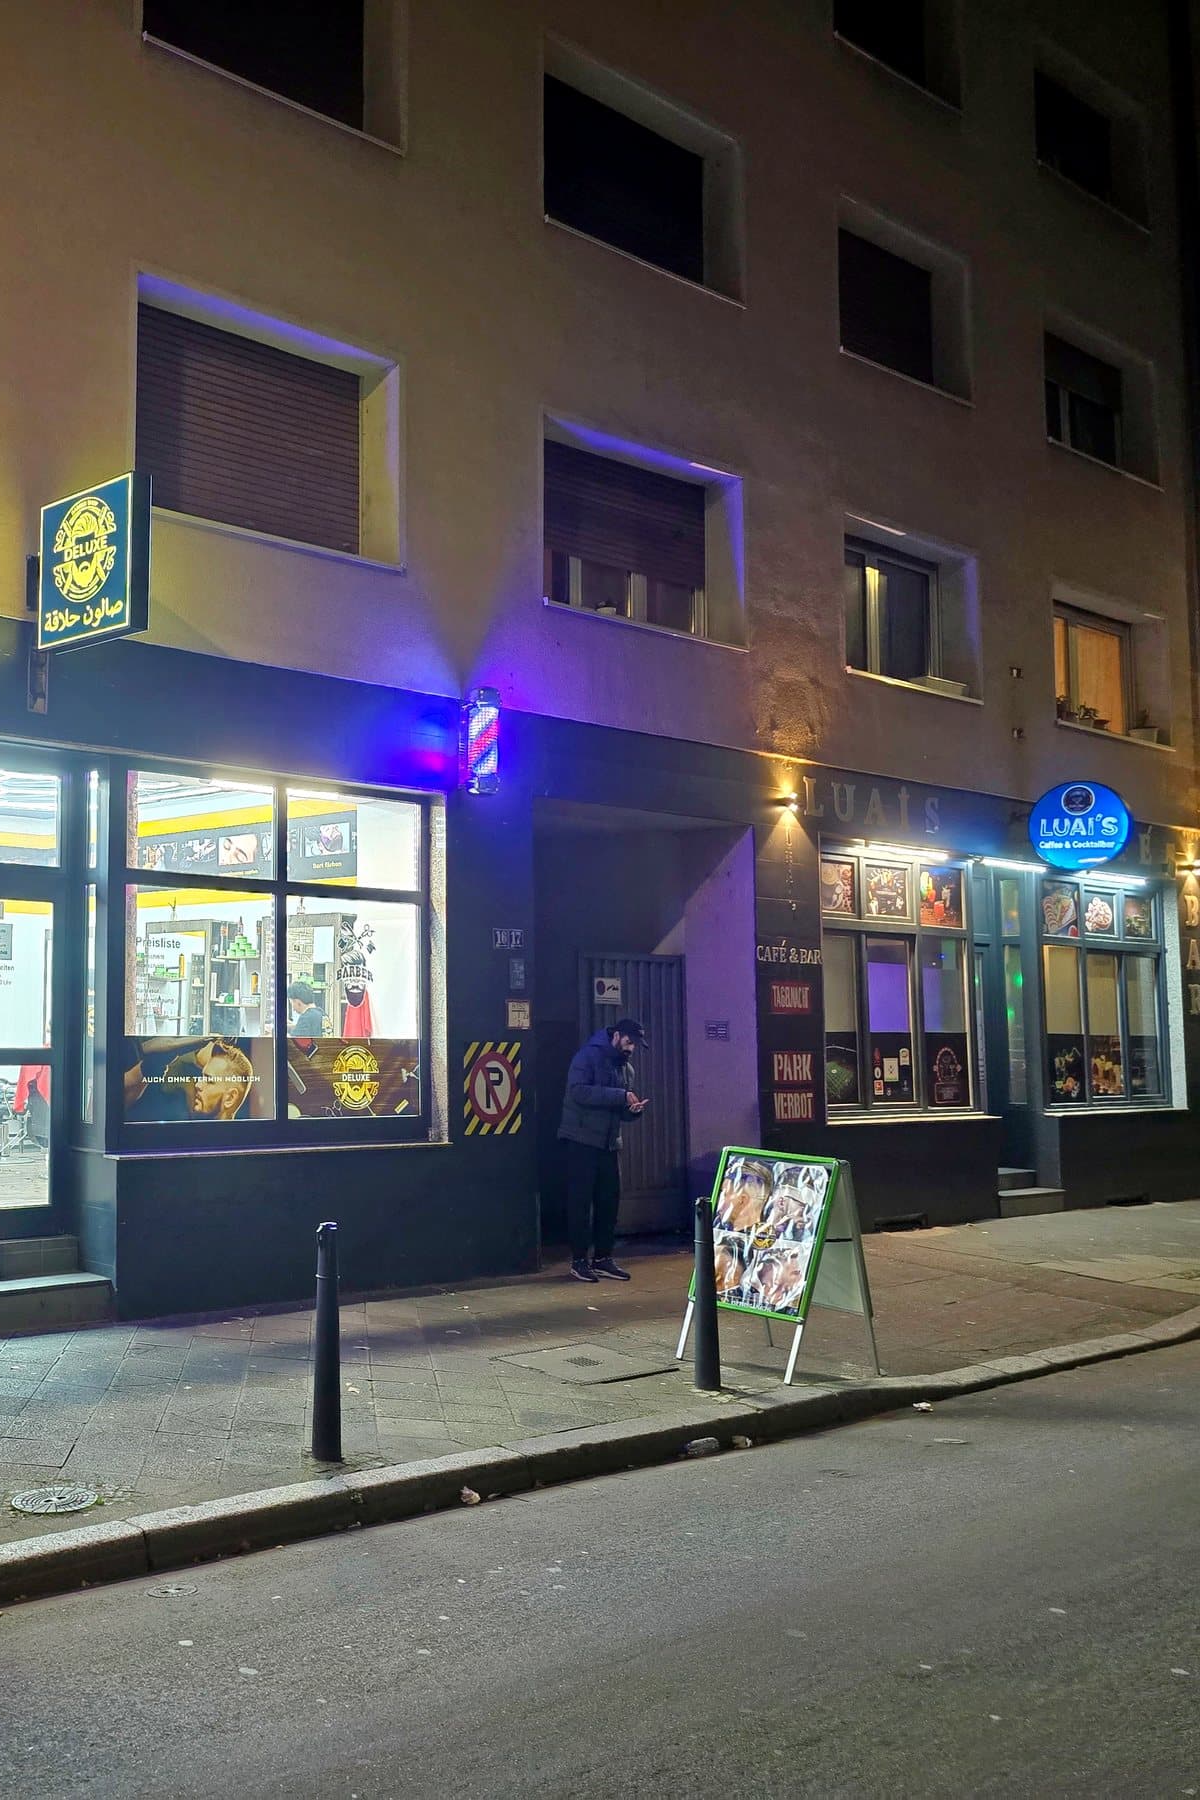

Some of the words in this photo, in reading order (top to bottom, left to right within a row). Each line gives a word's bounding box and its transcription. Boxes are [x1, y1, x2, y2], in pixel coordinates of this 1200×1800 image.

[64, 536, 108, 562] DELUXE
[44, 606, 81, 632] حلاقة
[84, 598, 124, 627] صالون
[1064, 841, 1071, 849] &
[136, 936, 181, 949] Preisliste
[495, 931, 508, 945] 16
[510, 931, 522, 945] 17
[756, 940, 787, 963] CAFÉ
[789, 947, 799, 964] &
[800, 949, 823, 965] BAR
[336, 965, 374, 983] BARBER
[341, 1073, 371, 1082] DELUXE
[773, 1054, 812, 1081] PARK
[224, 1074, 261, 1083] MÖGLICH
[773, 1092, 813, 1120] VERBOT
